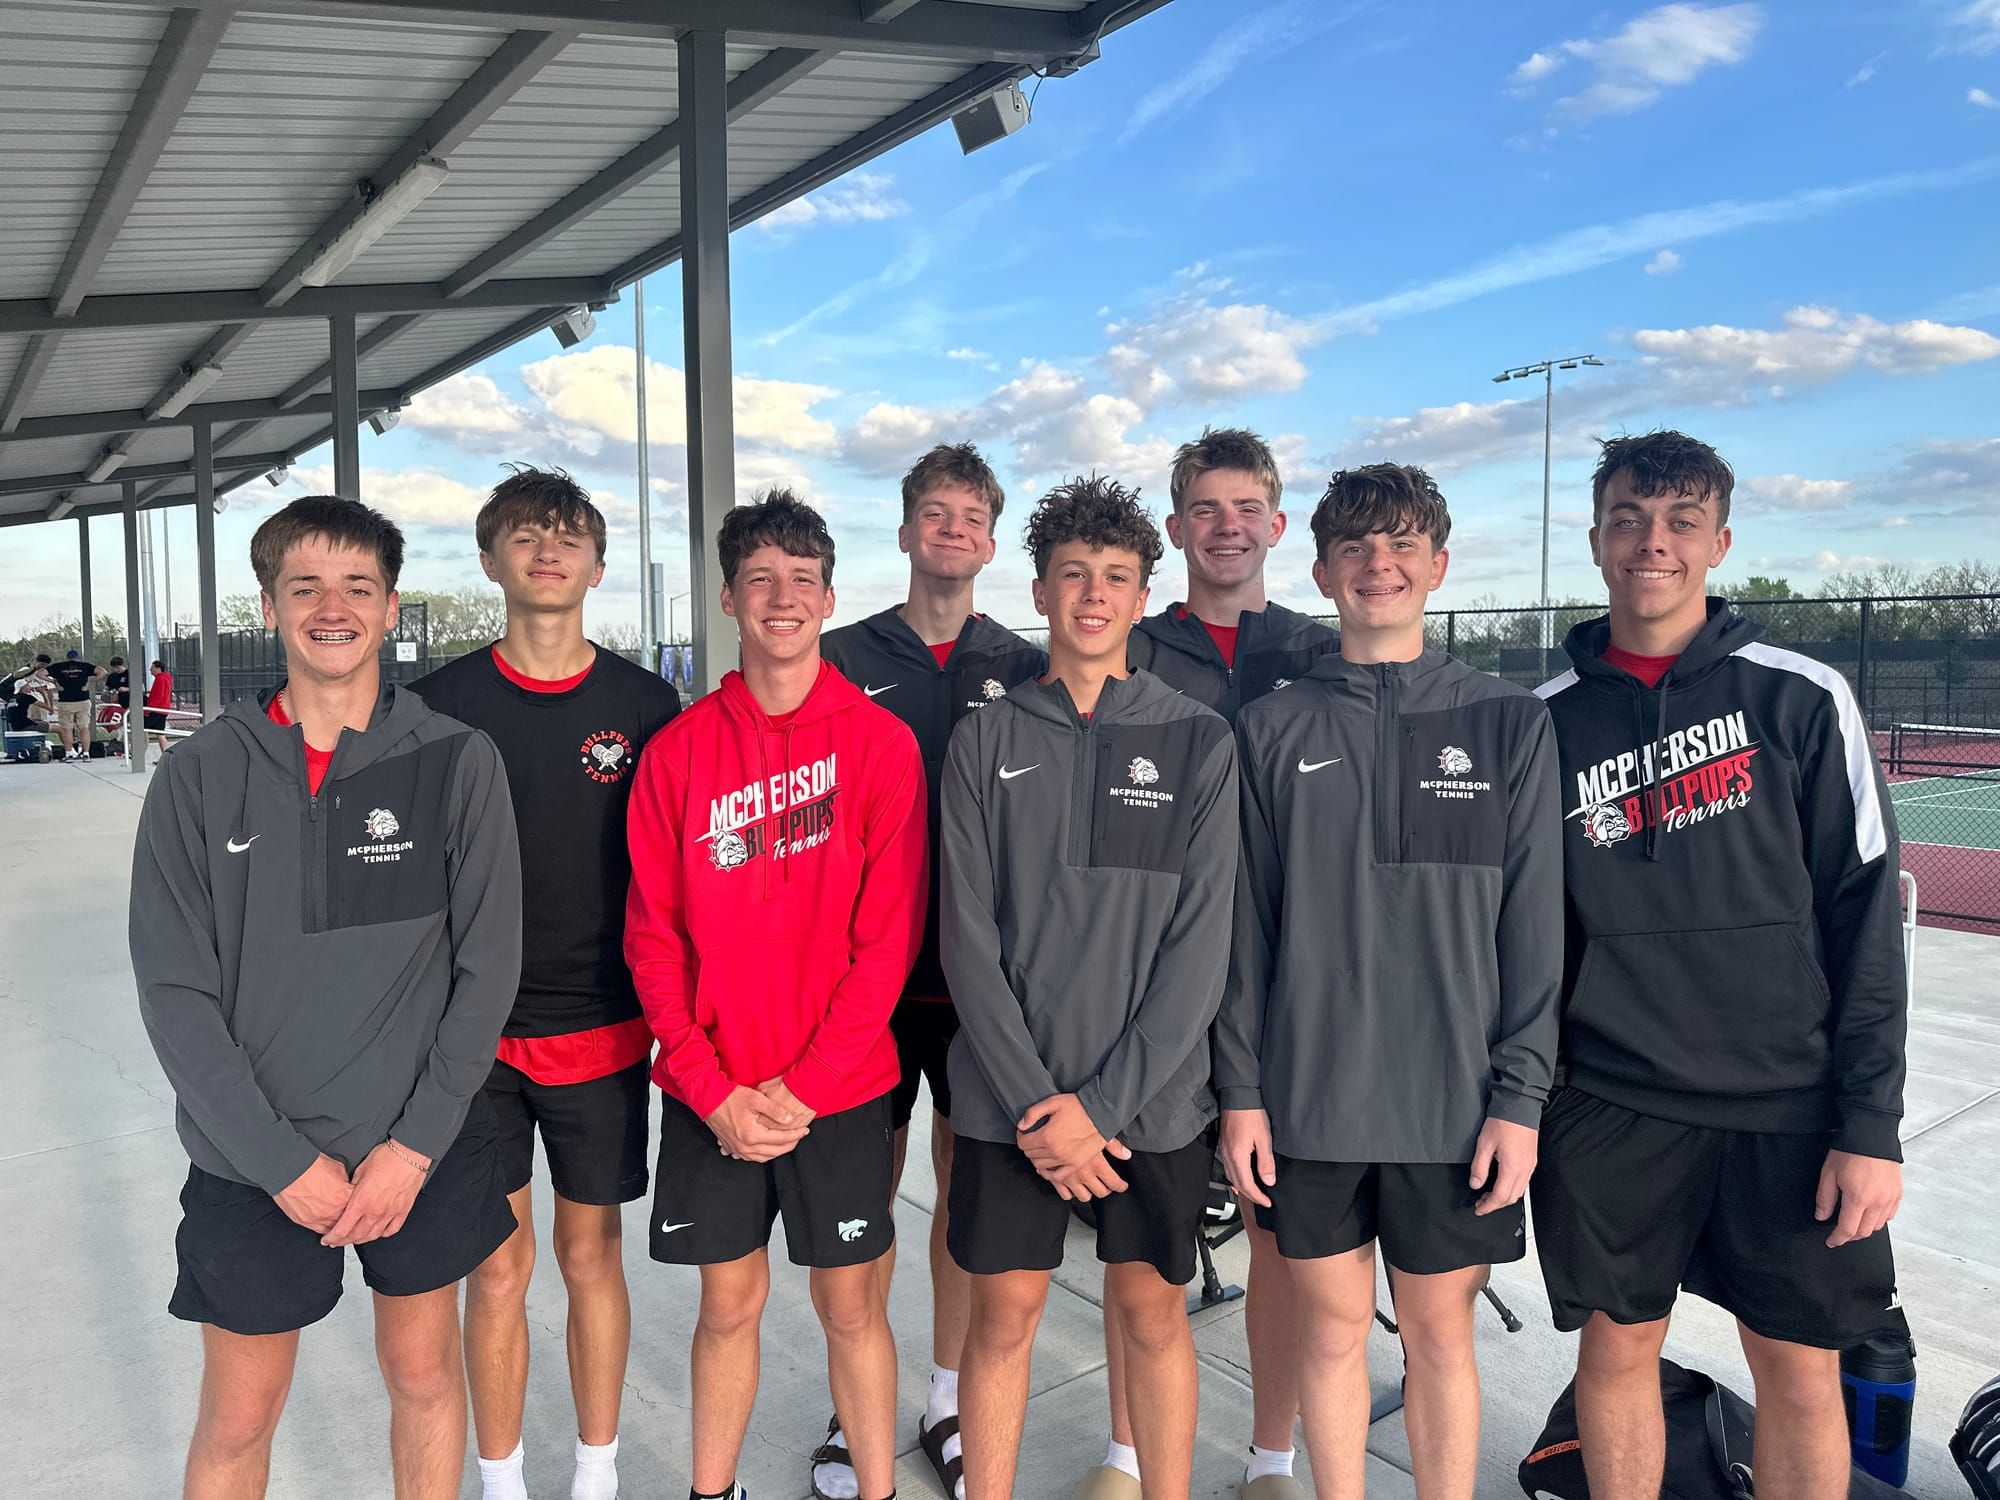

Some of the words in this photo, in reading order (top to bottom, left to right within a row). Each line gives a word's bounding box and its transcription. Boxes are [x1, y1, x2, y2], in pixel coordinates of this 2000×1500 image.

[581, 731, 632, 754] BULLPUPS
[585, 765, 627, 784] TENNIS
[1576, 710, 1750, 810] MCPHERSON
[709, 752, 837, 834] MCPHERSON
[1123, 798, 1158, 808] TENNIS
[1435, 791, 1474, 799] TENNIS
[1663, 787, 1751, 832] Tennis
[746, 791, 836, 861] BULPUPS
[773, 824, 831, 861] Tennis
[363, 854, 400, 863] TENNIS
